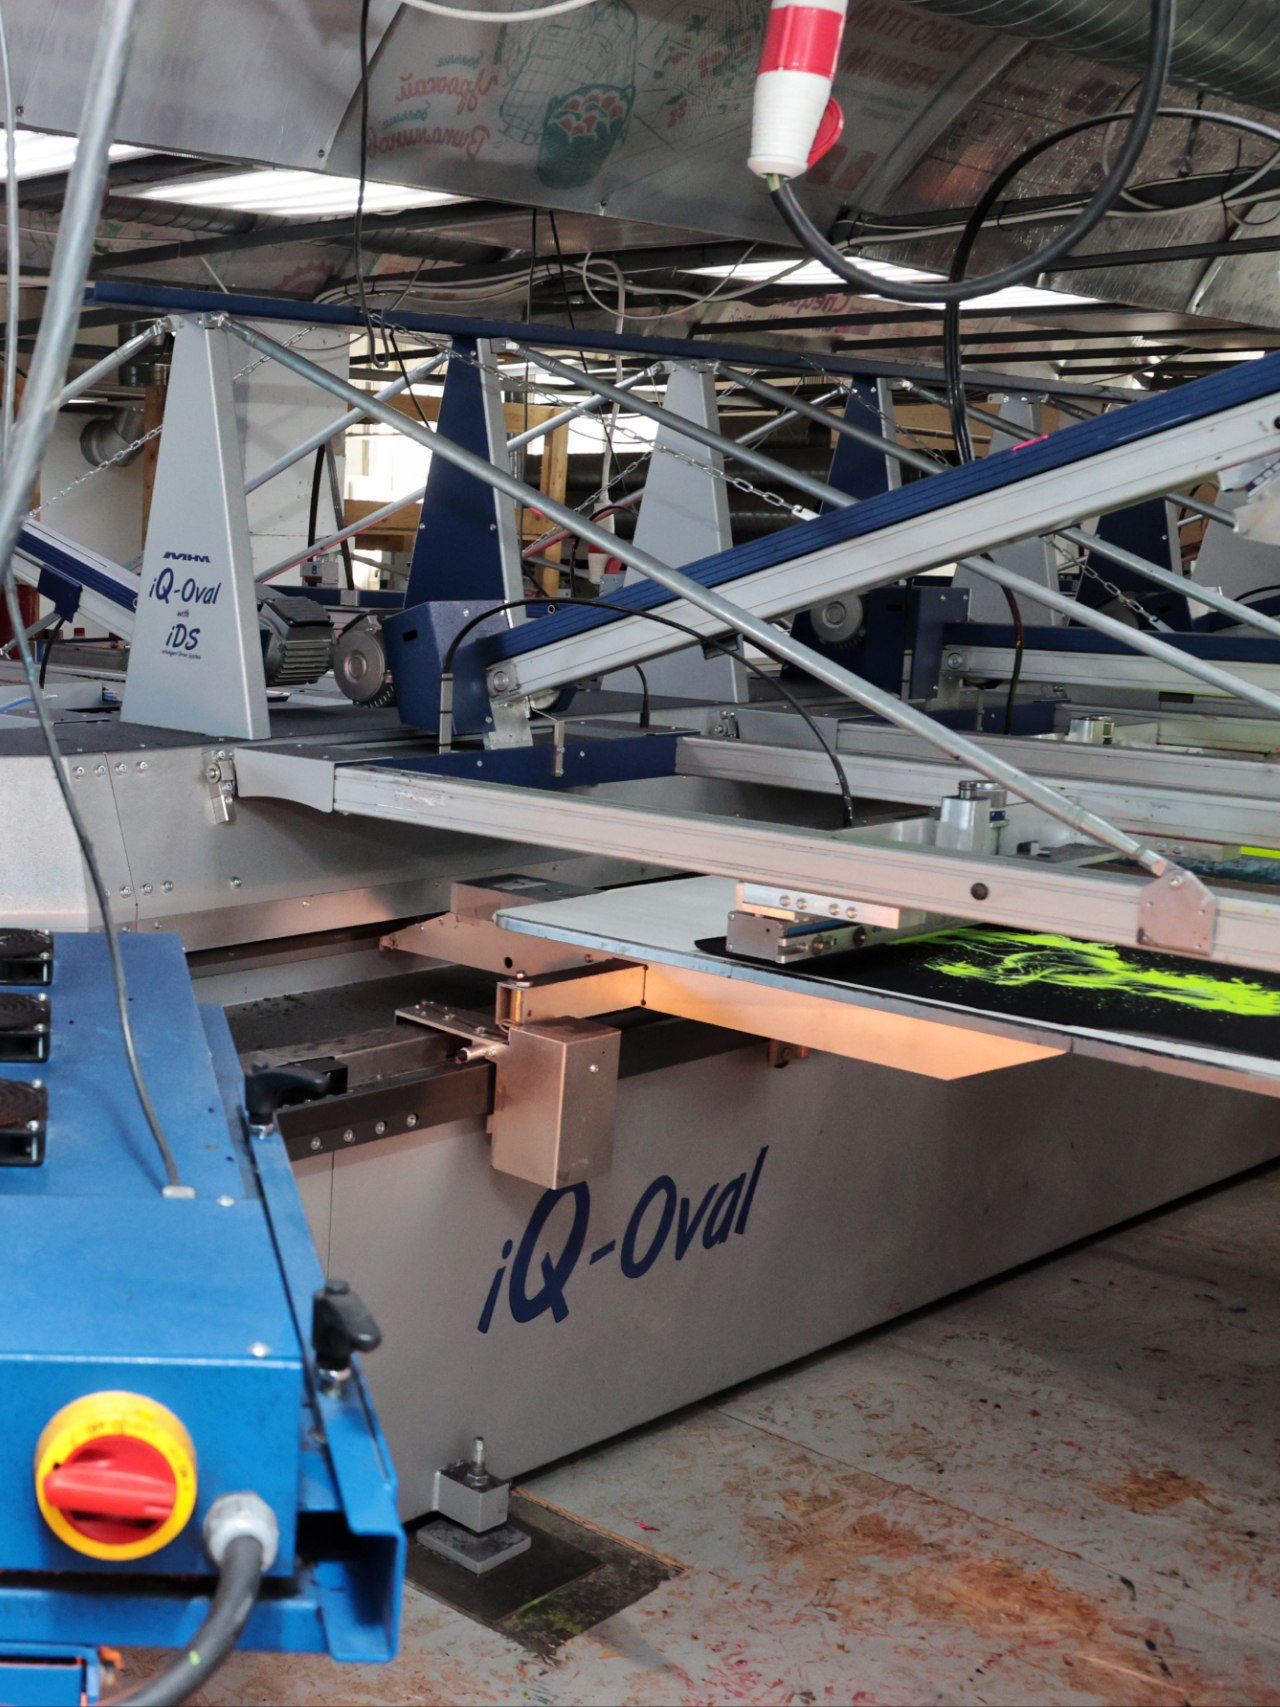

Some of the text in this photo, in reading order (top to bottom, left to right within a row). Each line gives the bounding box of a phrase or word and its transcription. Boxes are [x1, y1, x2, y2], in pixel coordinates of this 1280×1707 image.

[149, 567, 222, 605] iQ-Oval
[165, 623, 201, 651] iDS
[477, 1145, 769, 1334] iQ-Oval
